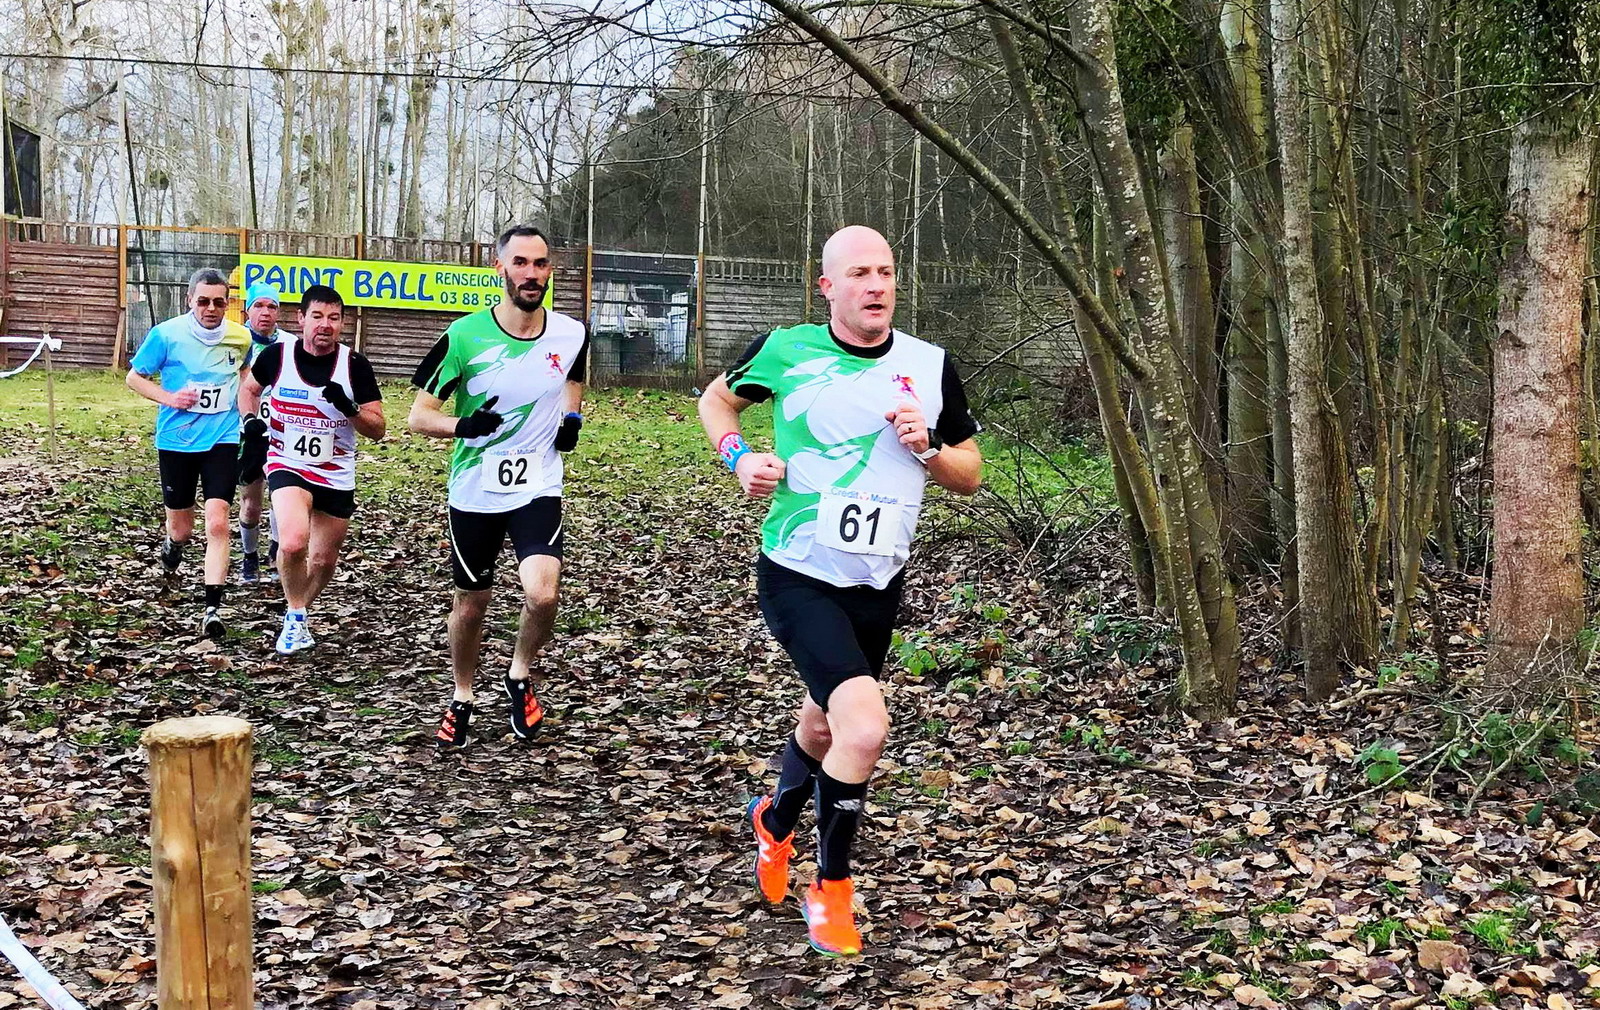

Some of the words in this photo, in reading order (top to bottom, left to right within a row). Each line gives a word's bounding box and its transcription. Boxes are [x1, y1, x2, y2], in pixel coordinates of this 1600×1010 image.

[246, 264, 343, 293] PAINT
[354, 270, 434, 301] BALL
[440, 291, 457, 304] 03
[462, 293, 479, 305] 88
[484, 294, 501, 306] 59
[200, 388, 221, 409] 57
[277, 414, 317, 426] ALSACE
[320, 419, 348, 428] NORD
[294, 435, 321, 457] 46
[498, 458, 528, 486] 62
[839, 504, 881, 545] 61
